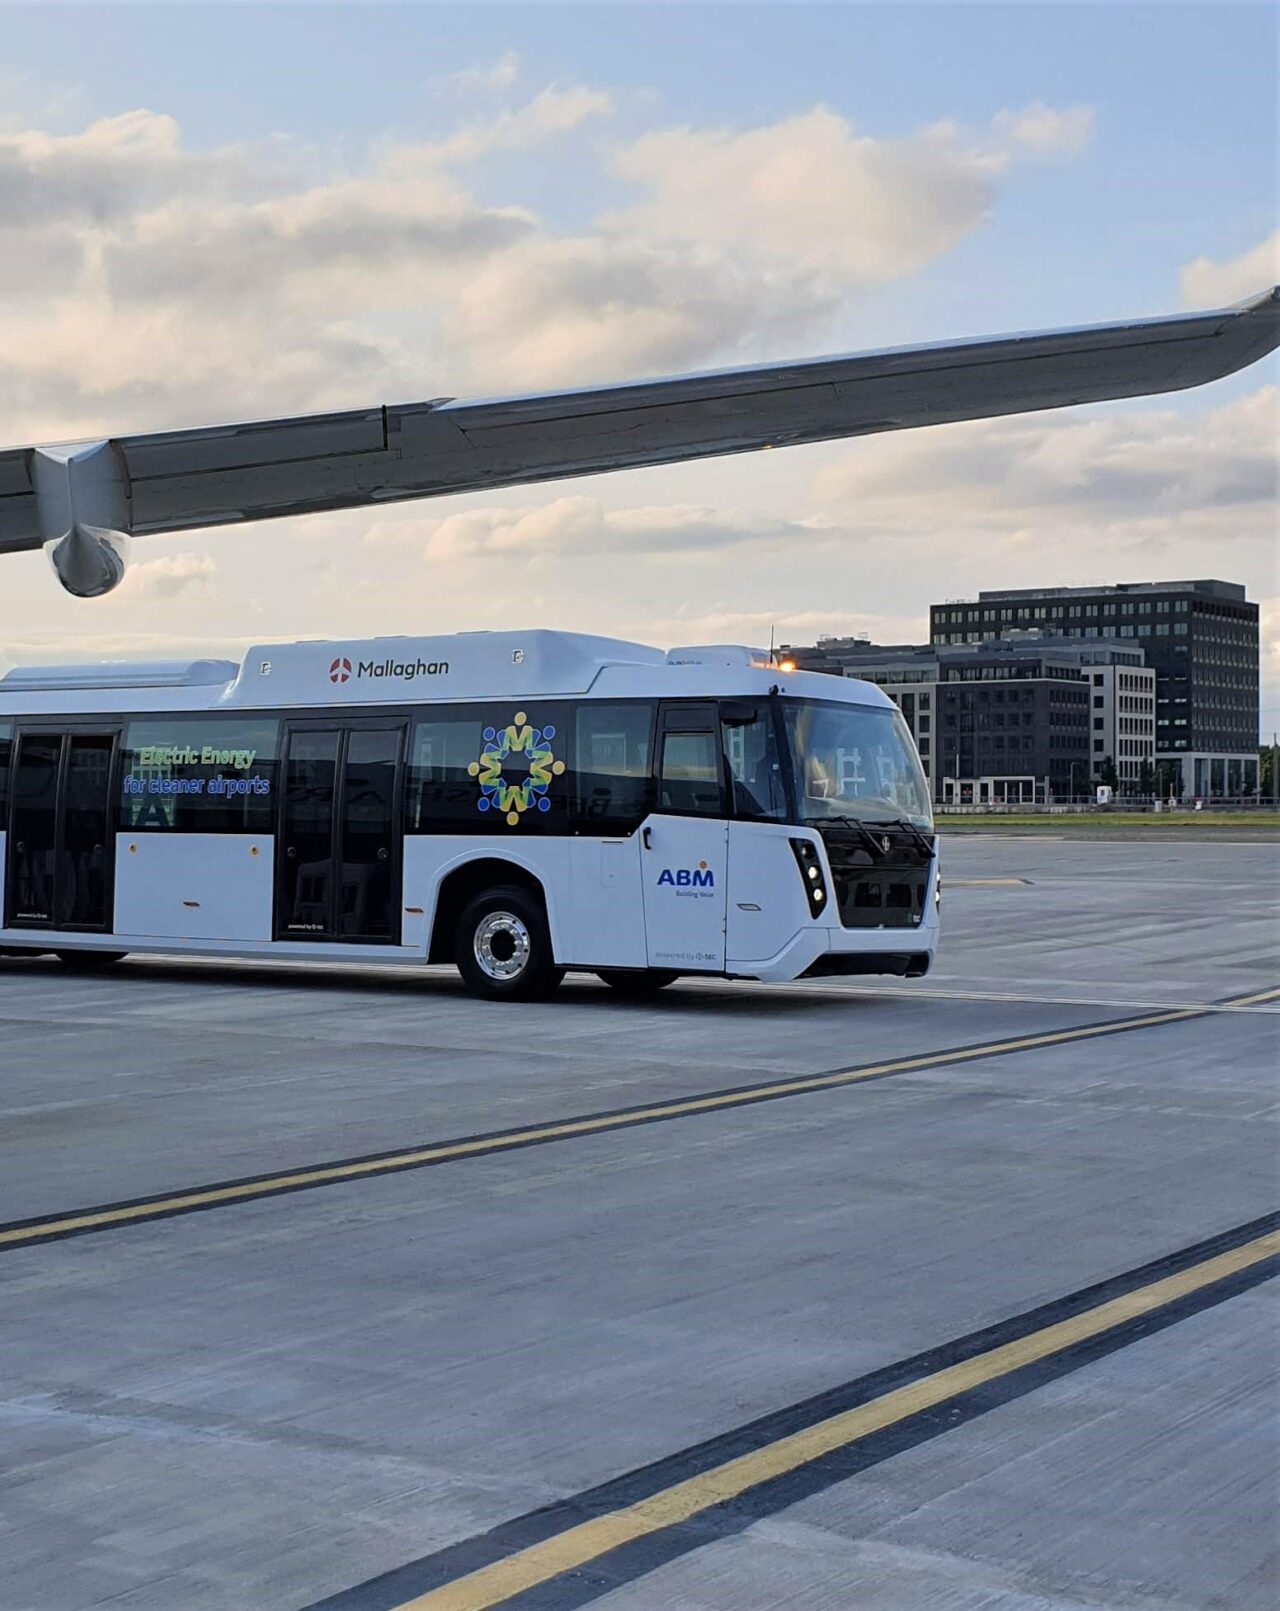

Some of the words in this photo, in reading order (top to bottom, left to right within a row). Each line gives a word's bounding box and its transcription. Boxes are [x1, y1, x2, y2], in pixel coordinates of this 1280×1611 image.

[357, 658, 449, 680] Mallaghan
[139, 746, 199, 765] Electric
[201, 746, 257, 770] Energy
[124, 775, 146, 794] for
[147, 775, 205, 794] cleaner
[207, 774, 271, 799] airports
[657, 869, 714, 887] ABM
